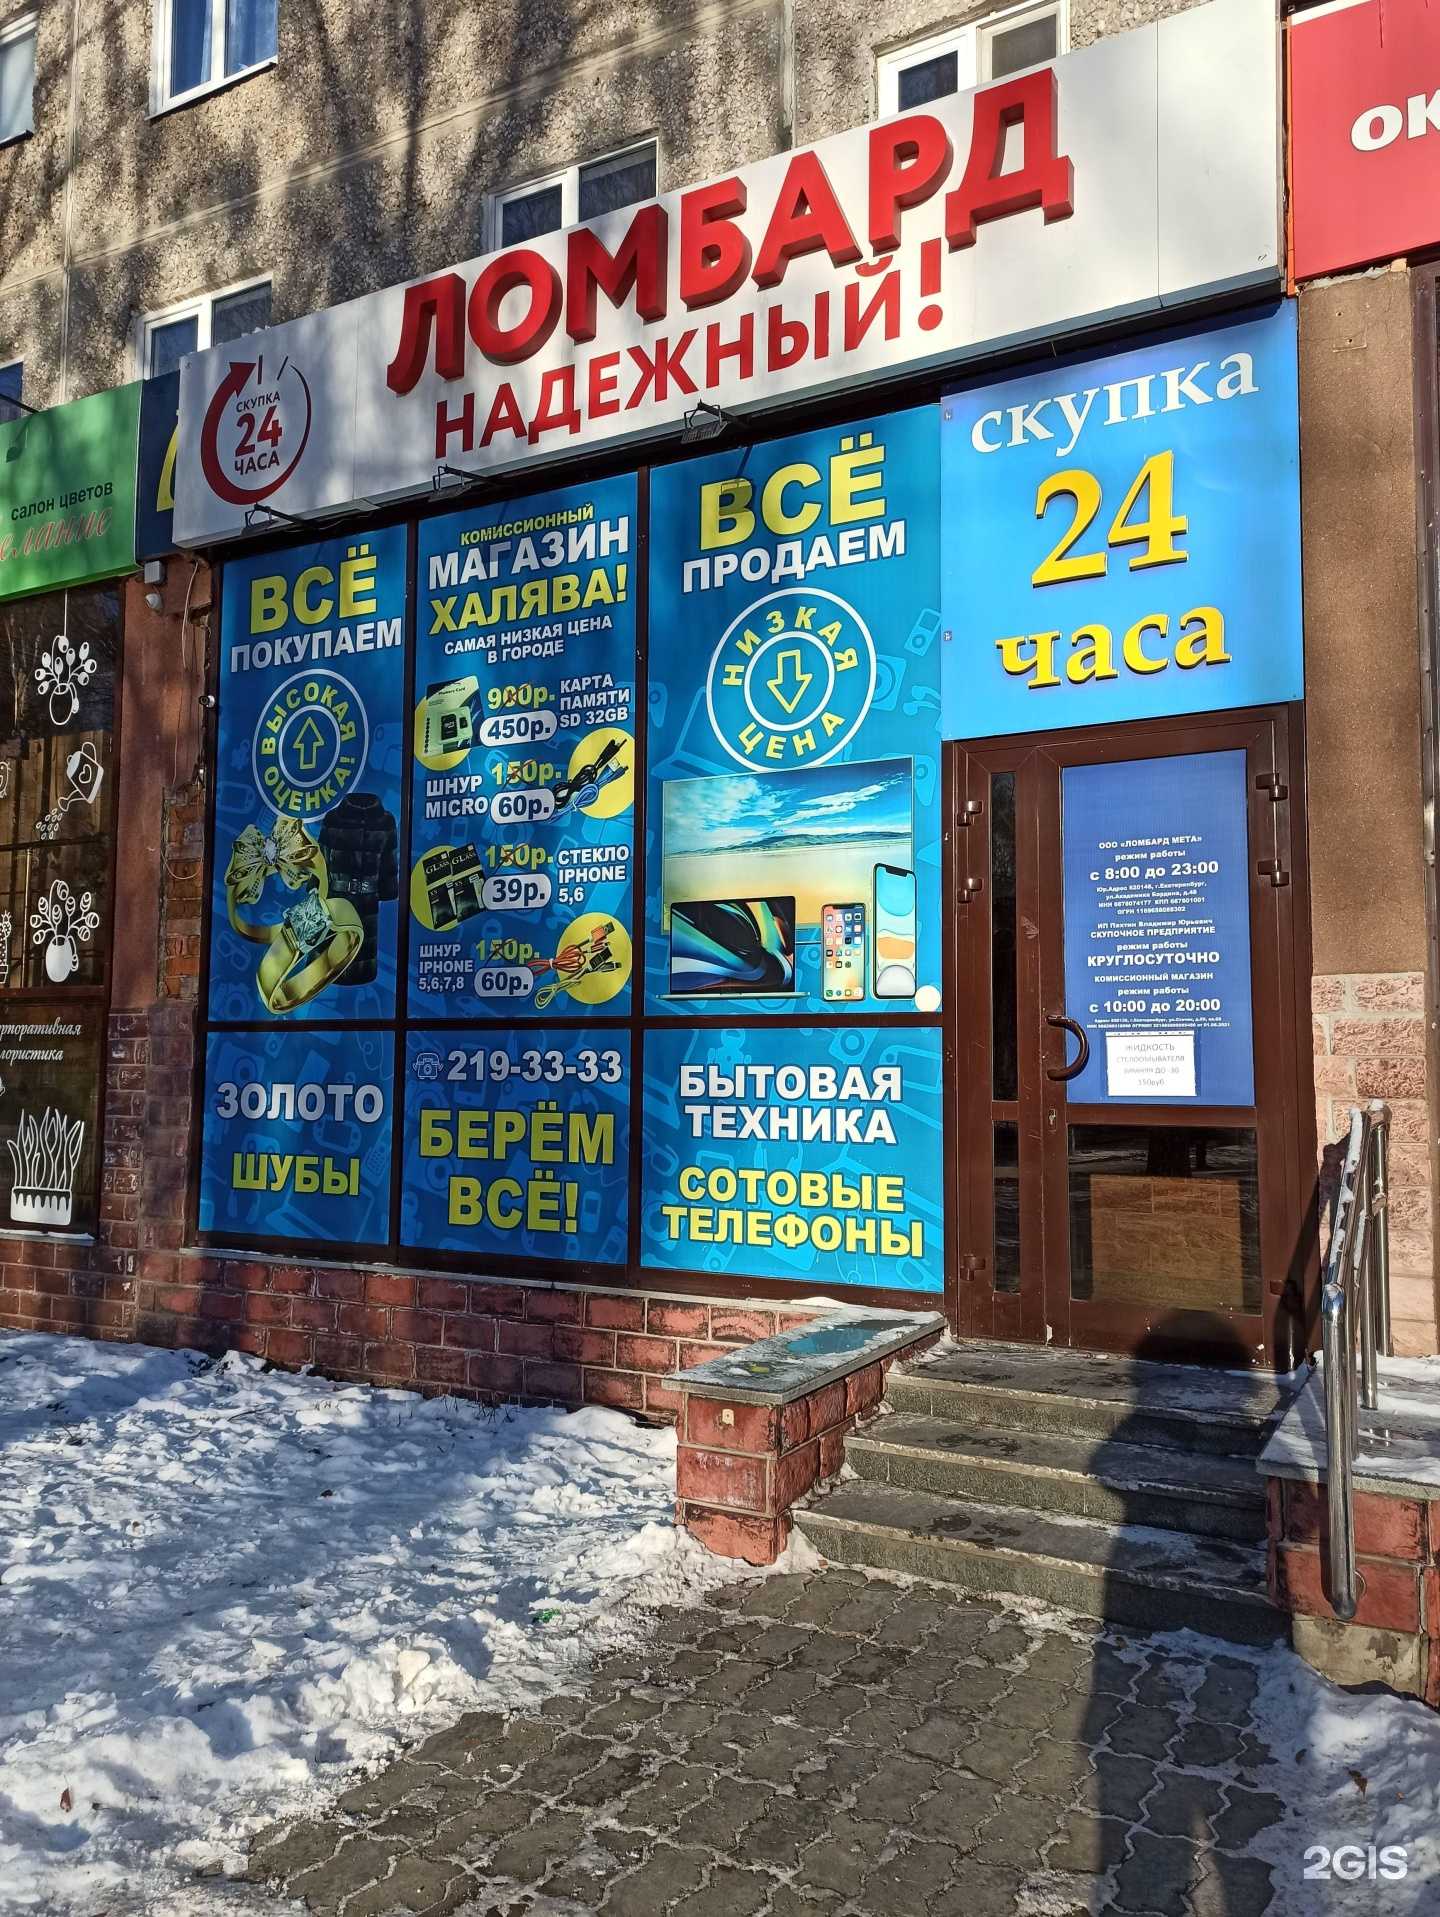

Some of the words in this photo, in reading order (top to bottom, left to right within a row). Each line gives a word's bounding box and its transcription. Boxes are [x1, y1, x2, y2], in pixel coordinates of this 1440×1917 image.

[386, 67, 1074, 398] ЛОМБАРД
[435, 236, 941, 459] НАДЕЖНЫЙ!
[235, 390, 281, 413] СКУПКА
[971, 351, 1258, 457] скупка
[235, 405, 282, 457] 24
[234, 452, 280, 475] ЧАСА
[11, 498, 54, 521] салон
[59, 482, 113, 509] цветов
[699, 431, 885, 551] ВСЁ
[460, 503, 594, 546] КОМИССИОННЫЙ
[1031, 449, 1190, 588] 24
[429, 516, 629, 590] МАГАЗИН
[683, 520, 905, 594] ПРОДАЕМ
[250, 544, 377, 634] ВСЁ
[429, 564, 628, 635] ХАЛЯВА!
[231, 617, 402, 672] ПОКУПАЕМ
[444, 633, 496, 655] САМАЯ
[500, 623, 563, 645] НИЗКАЯ
[567, 615, 613, 636] ЦЕНА
[722, 605, 858, 687] НИЗКАЯ
[995, 605, 1233, 690] часа
[487, 650, 498, 664] В
[502, 640, 564, 661] ГОРОДЕ
[487, 683, 555, 709] 900р.
[560, 673, 613, 693] КАРТА
[560, 688, 630, 711] ПАМЯТИ
[261, 681, 357, 755] ВЫСОКАЯ
[487, 716, 551, 740] 450р.
[560, 712, 581, 728] SD
[585, 706, 628, 725] 32GB
[737, 710, 846, 760] ЦЕНА
[264, 756, 356, 812] ОЦЕНКА!
[491, 759, 562, 785] 150р.
[426, 775, 483, 797] ШНУР
[425, 796, 488, 818] MICRO
[498, 794, 550, 819] 60р.
[1099, 841, 1118, 849] ООО
[1120, 838, 1170, 848] «ЛОМБАРД
[1171, 835, 1203, 844] МЕТА»
[485, 843, 554, 871] 150р.
[558, 846, 629, 866] СТЕКЛО
[1115, 852, 1148, 862] режим
[1150, 850, 1186, 860] работы
[558, 865, 626, 883] IPHONE
[1089, 871, 1100, 881] с
[1104, 866, 1140, 880] 8:00
[1145, 868, 1166, 879] до
[1171, 861, 1219, 876] 23:00
[492, 879, 546, 906] 39р.
[558, 888, 584, 904] 5,6
[1090, 929, 1145, 939] СКУПОЧНОЕ
[1147, 926, 1216, 937] ПРЕДПРИЯТИЕ
[1138, 920, 1177, 928] Владимир
[419, 944, 462, 959] ШНУР
[476, 938, 540, 965] 150р.
[1087, 952, 1220, 967] КРУГЛОСУТОЧНО
[1116, 943, 1149, 952] режим
[1152, 941, 1188, 951] работы
[419, 960, 473, 973] IPHONE
[1094, 972, 1169, 983] КОМИССИОННЫЙ
[1171, 972, 1213, 981] МАГАЗИН
[418, 976, 464, 992] 5,6,7,8
[481, 971, 529, 995] 60р.
[1117, 988, 1150, 997] режим
[1153, 986, 1189, 996] работы
[1089, 1004, 1099, 1013] с
[1103, 1000, 1146, 1013] 10:00
[1150, 1002, 1171, 1013] до
[1175, 999, 1221, 1011] 20:00
[1125, 1043, 1175, 1052] ЖИДКОСТЬ
[447, 1050, 622, 1082] 219-33-33
[680, 1065, 901, 1101] БЫТОВАЯ
[216, 1082, 384, 1123] ЗОЛОТО
[420, 1101, 614, 1164] БЕРЁМ
[684, 1105, 897, 1144] ТЕХНИКА
[232, 1152, 360, 1196] ШУБЫ
[448, 1170, 579, 1233] ВСЁ!
[679, 1166, 905, 1212] СОТОВЫЕ
[662, 1206, 923, 1257] ТЕЛЕФОНЫ
